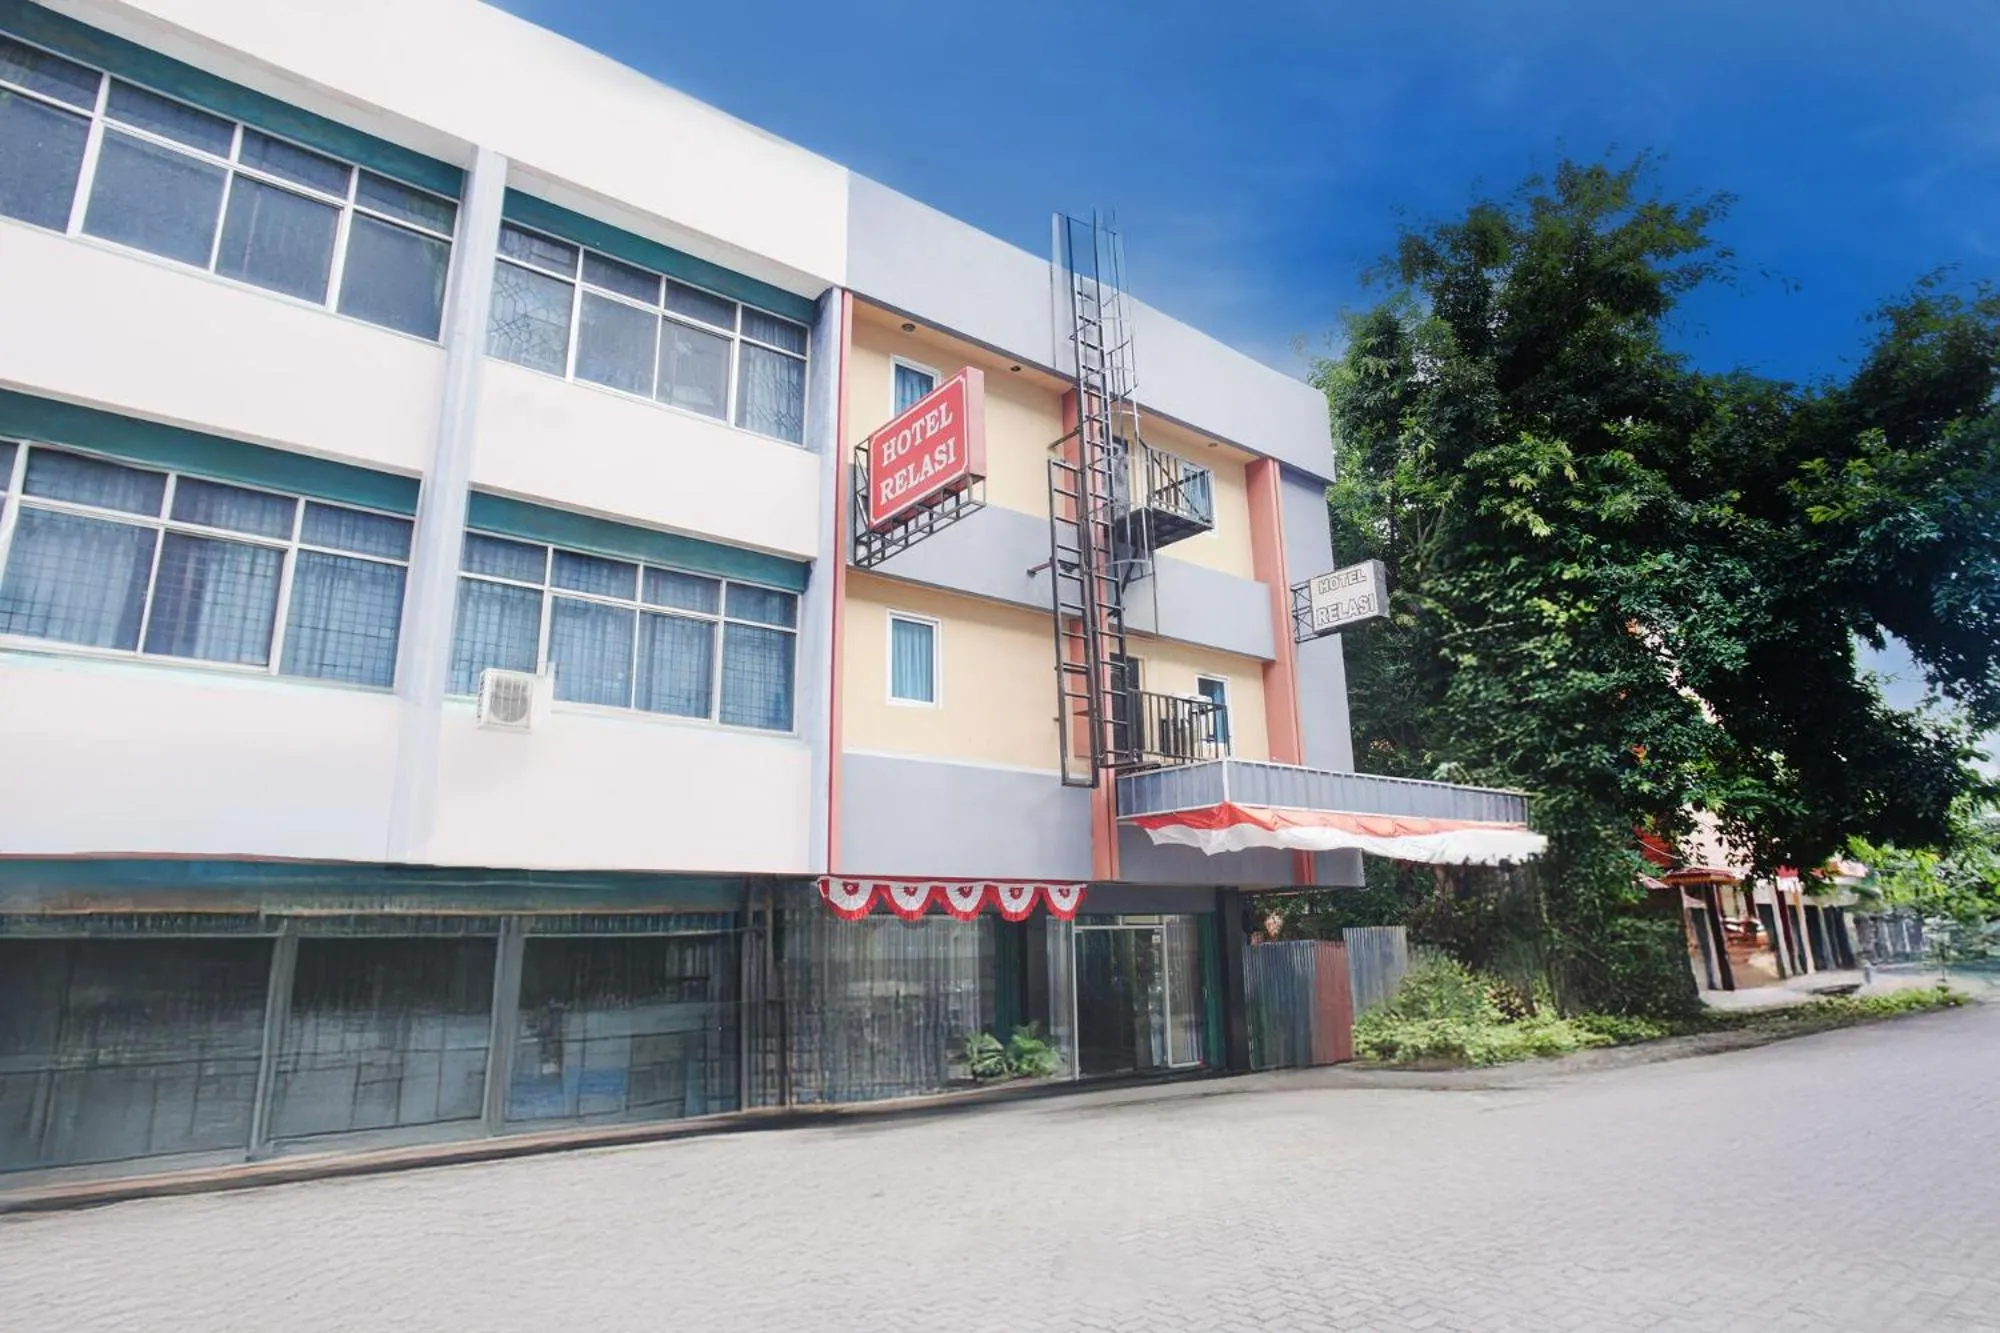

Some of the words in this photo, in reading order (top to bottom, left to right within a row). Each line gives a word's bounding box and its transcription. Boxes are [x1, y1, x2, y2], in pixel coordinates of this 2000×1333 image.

[882, 402, 953, 467] HOTEL
[880, 437, 957, 506] RELASI
[1319, 569, 1366, 595] HOTEL
[1317, 594, 1376, 626] RELASI
